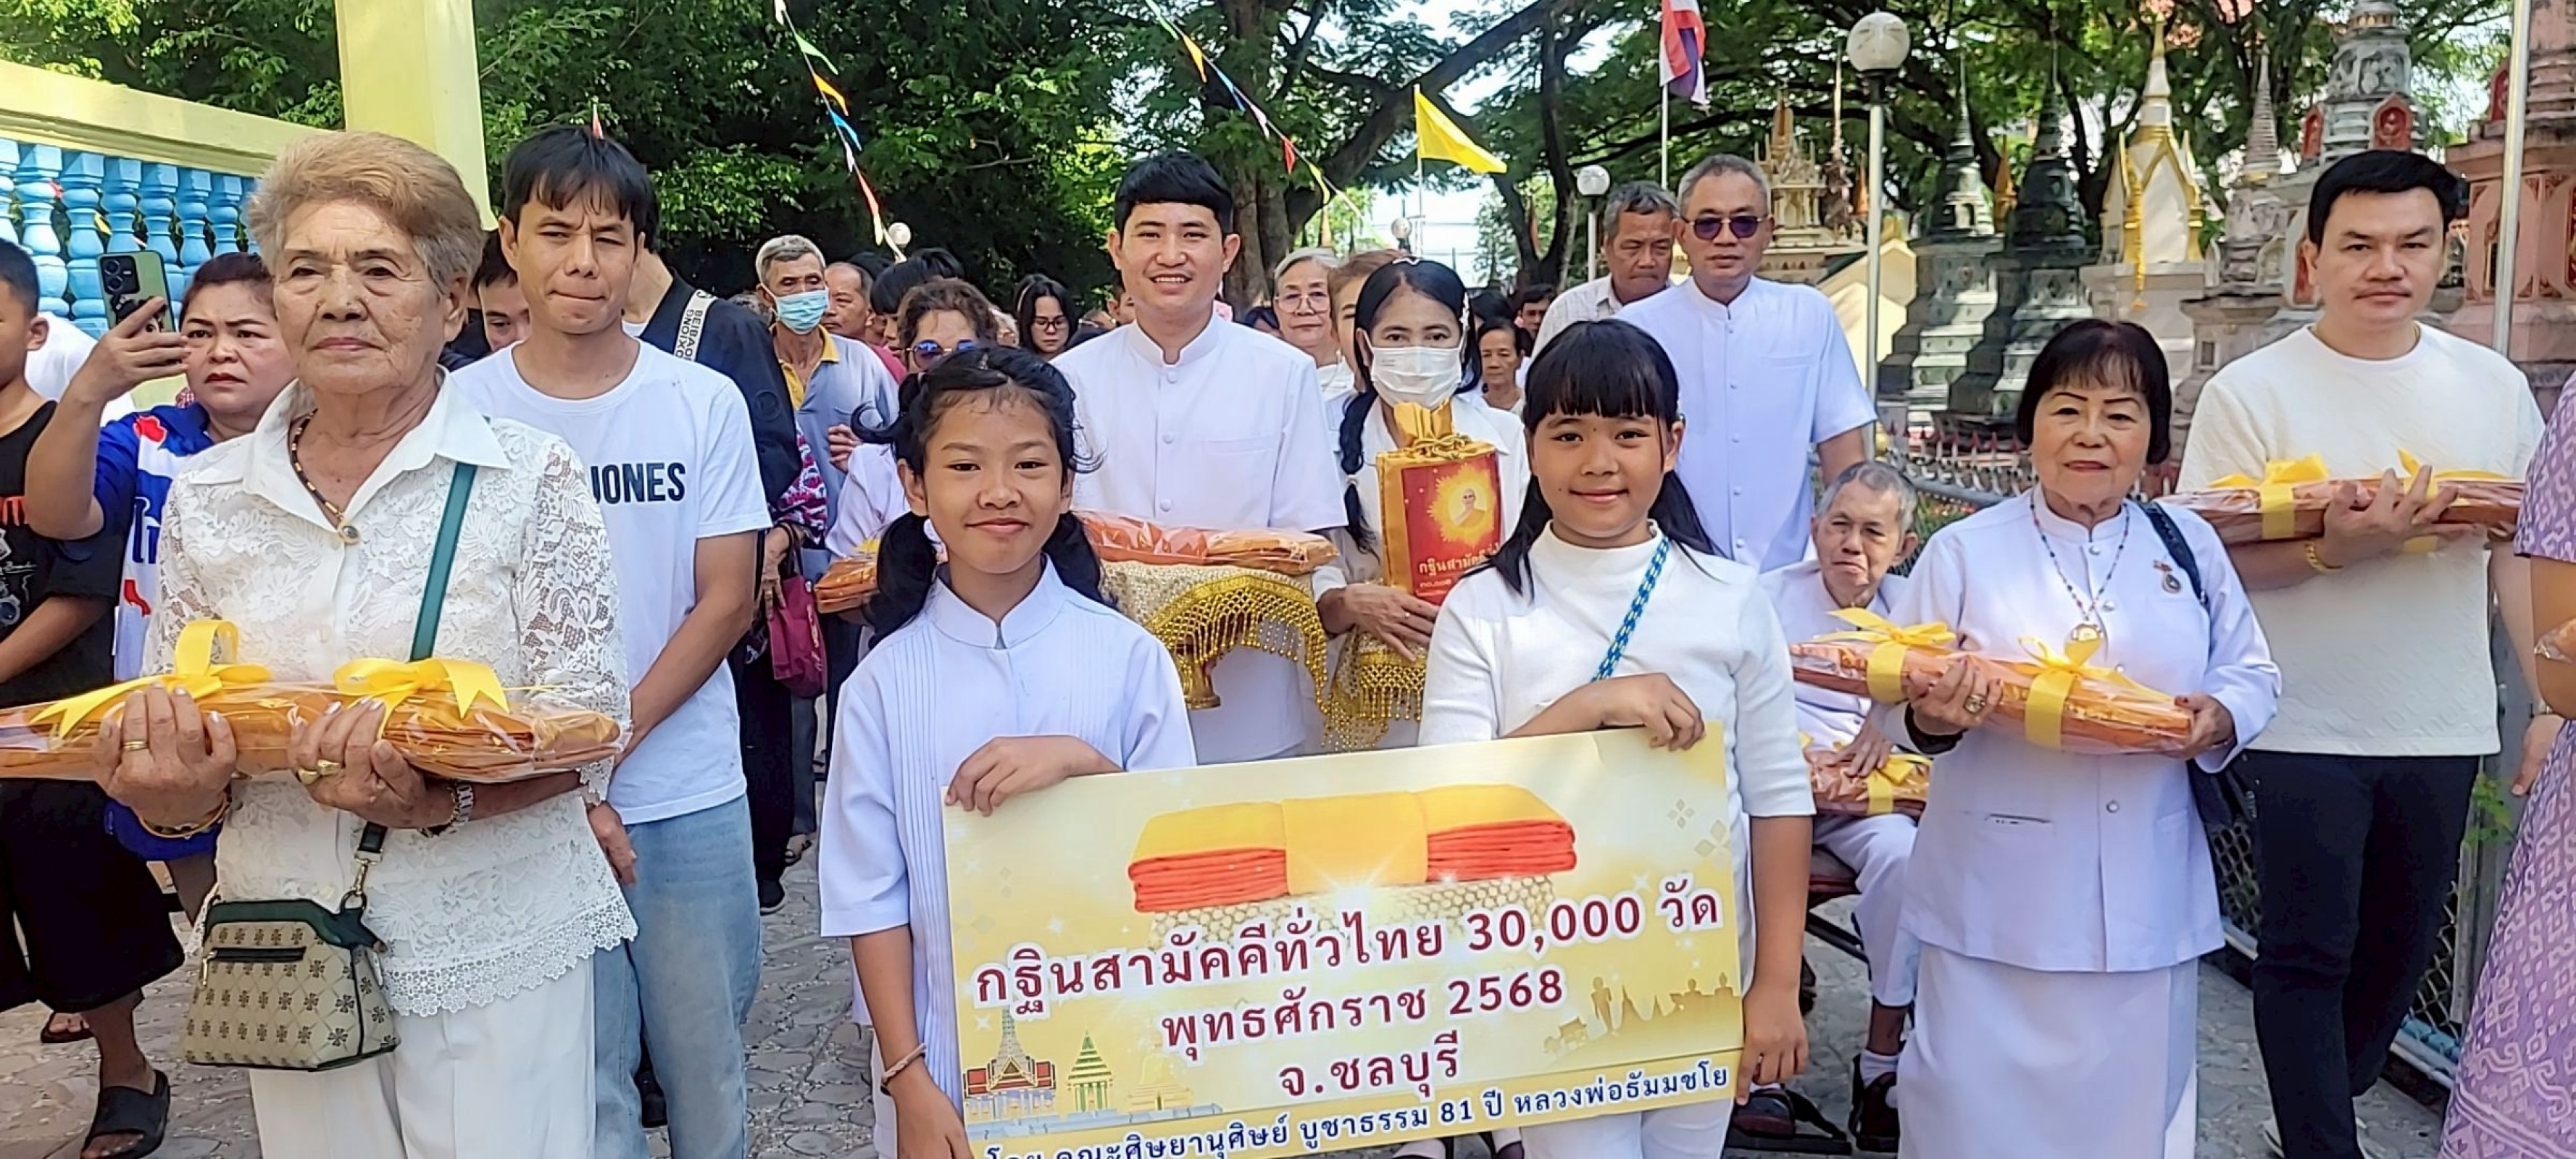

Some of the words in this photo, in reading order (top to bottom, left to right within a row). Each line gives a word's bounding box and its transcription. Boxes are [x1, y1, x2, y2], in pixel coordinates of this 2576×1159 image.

[975, 906, 1443, 1015] กฐินสามัคคีทั่วไทย
[1468, 896, 1641, 953] 30,000
[1661, 878, 1718, 928] วัด
[1162, 986, 1426, 1061] พุทธศักราช
[1448, 969, 1563, 1016] 2568
[1280, 1029, 1458, 1097] จ.ชลบุรี
[1299, 1109, 1428, 1150] บูชาธรรม
[1440, 1100, 1473, 1123] 81
[1484, 1089, 1502, 1118] ปี
[1514, 1060, 1727, 1114] หลวงพ่อธัมมชโย
